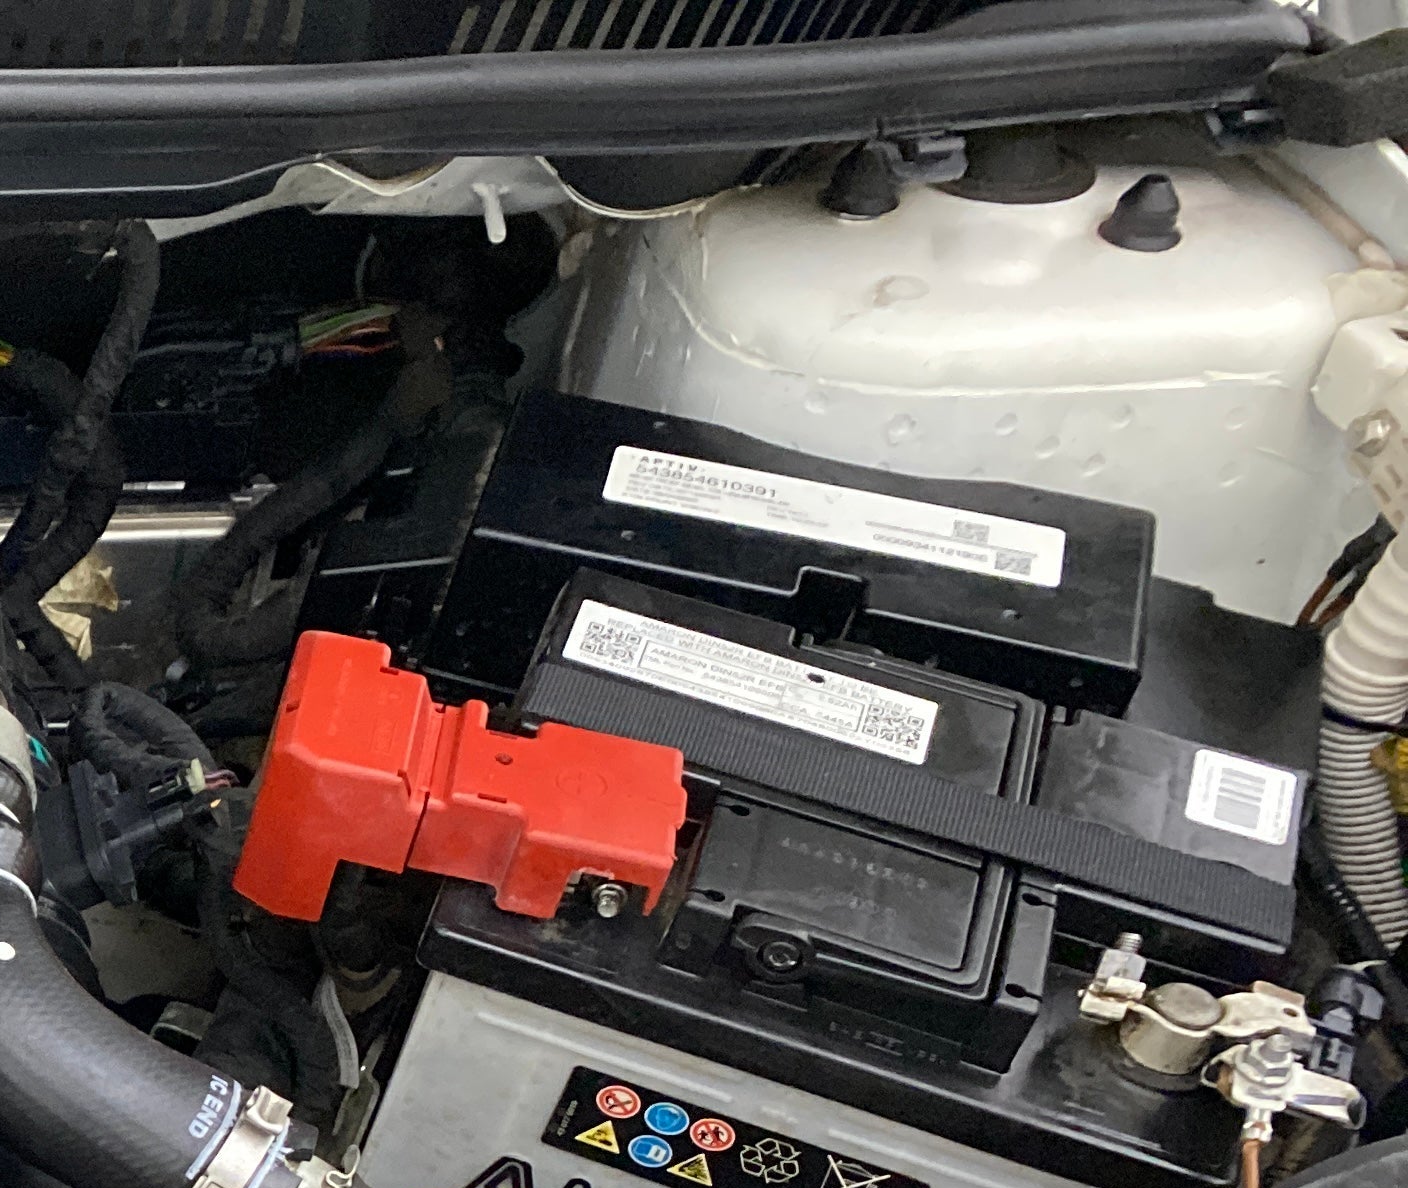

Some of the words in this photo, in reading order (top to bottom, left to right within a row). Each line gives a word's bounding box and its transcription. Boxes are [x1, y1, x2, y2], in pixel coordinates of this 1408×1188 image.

[607, 618, 674, 643] REPLACED
[651, 647, 707, 668] AMARON
[210, 1074, 228, 1095] IC
[188, 1094, 224, 1138] END
